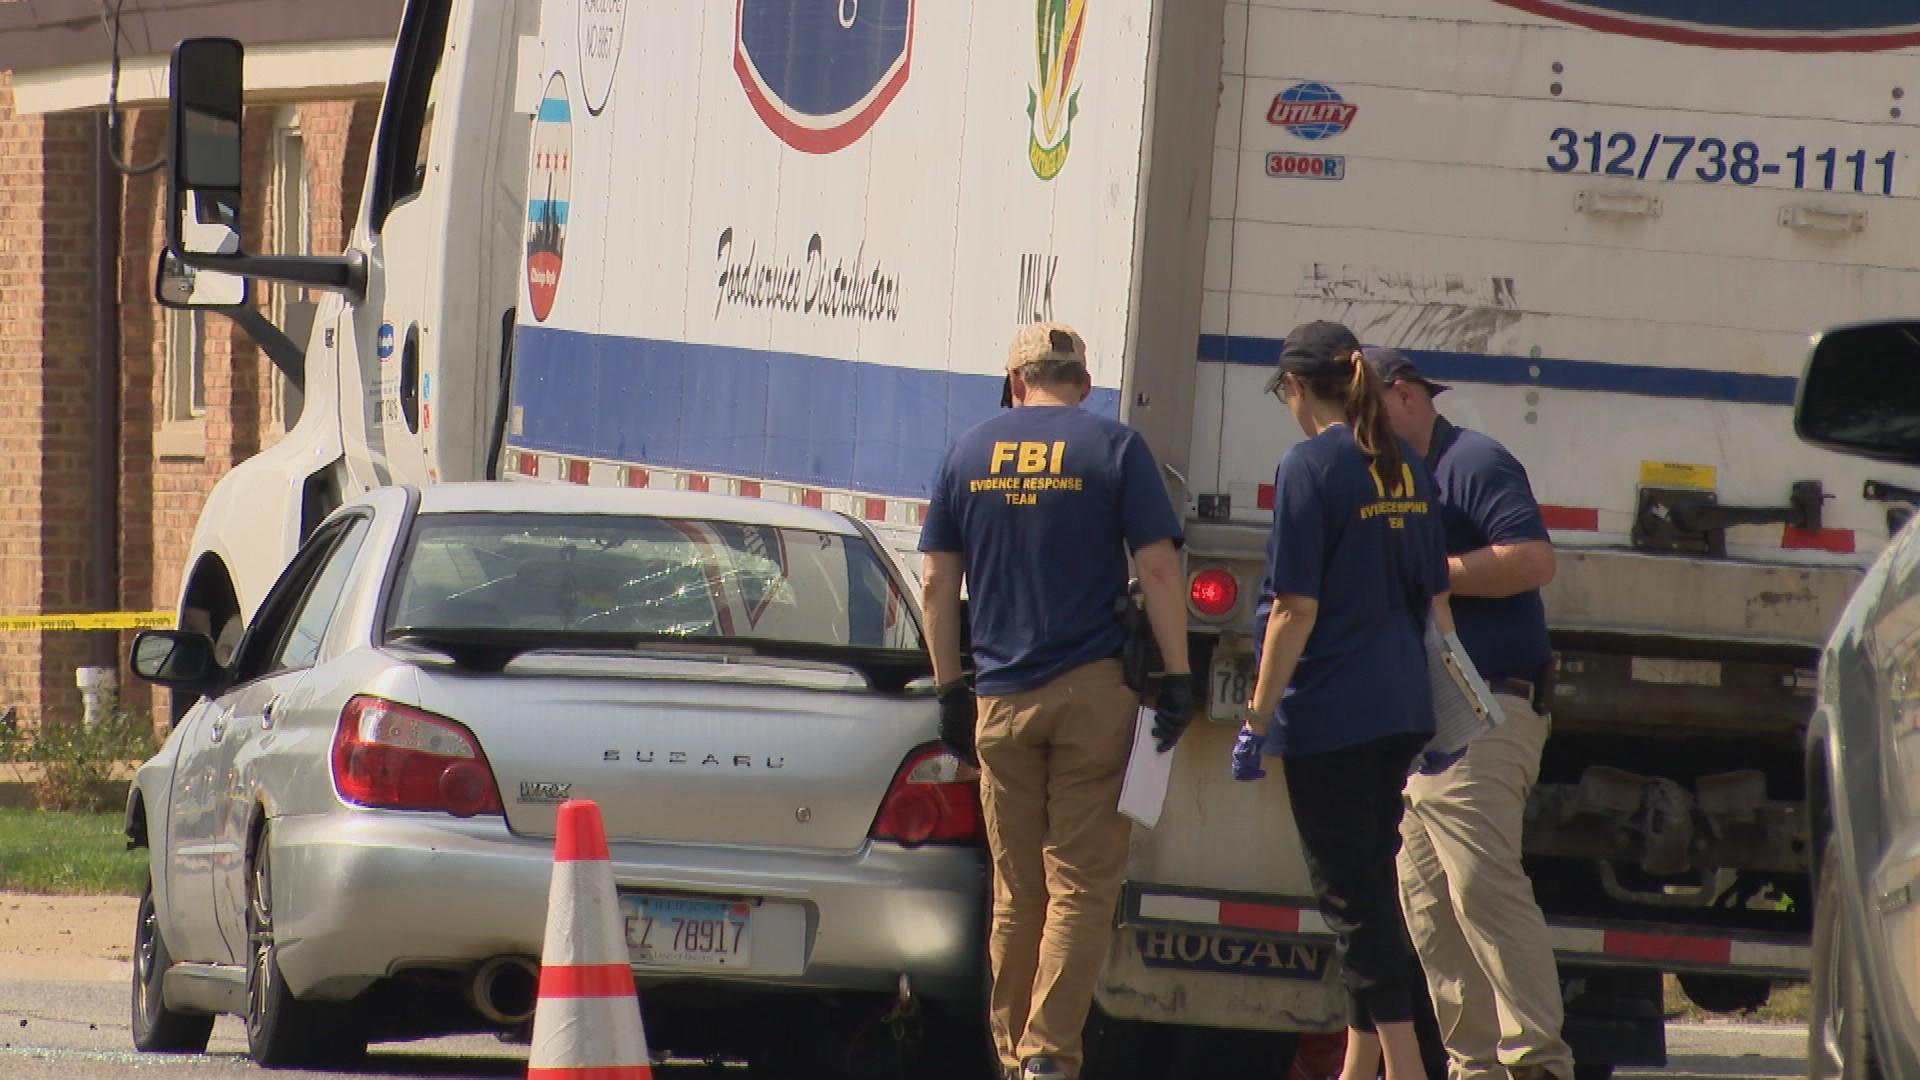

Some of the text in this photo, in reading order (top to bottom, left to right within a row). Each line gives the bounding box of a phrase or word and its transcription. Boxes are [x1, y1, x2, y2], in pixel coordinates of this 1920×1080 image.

[1272, 102, 1354, 122] UTILITY
[1270, 155, 1337, 176] 3000R
[1547, 127, 1896, 195] 312/738-1111
[715, 226, 900, 322] Foodservice Distributors
[1017, 253, 1059, 324] MILK
[990, 441, 1066, 475] FBI
[970, 477, 1083, 493] EVIDENCE RESPONSE
[1005, 493, 1037, 505] TEAM
[1216, 671, 1255, 704] 78
[603, 749, 784, 768] SUBARU
[519, 781, 572, 799] WRX
[671, 917, 745, 956] 78917
[1143, 930, 1320, 972] HOGAN
